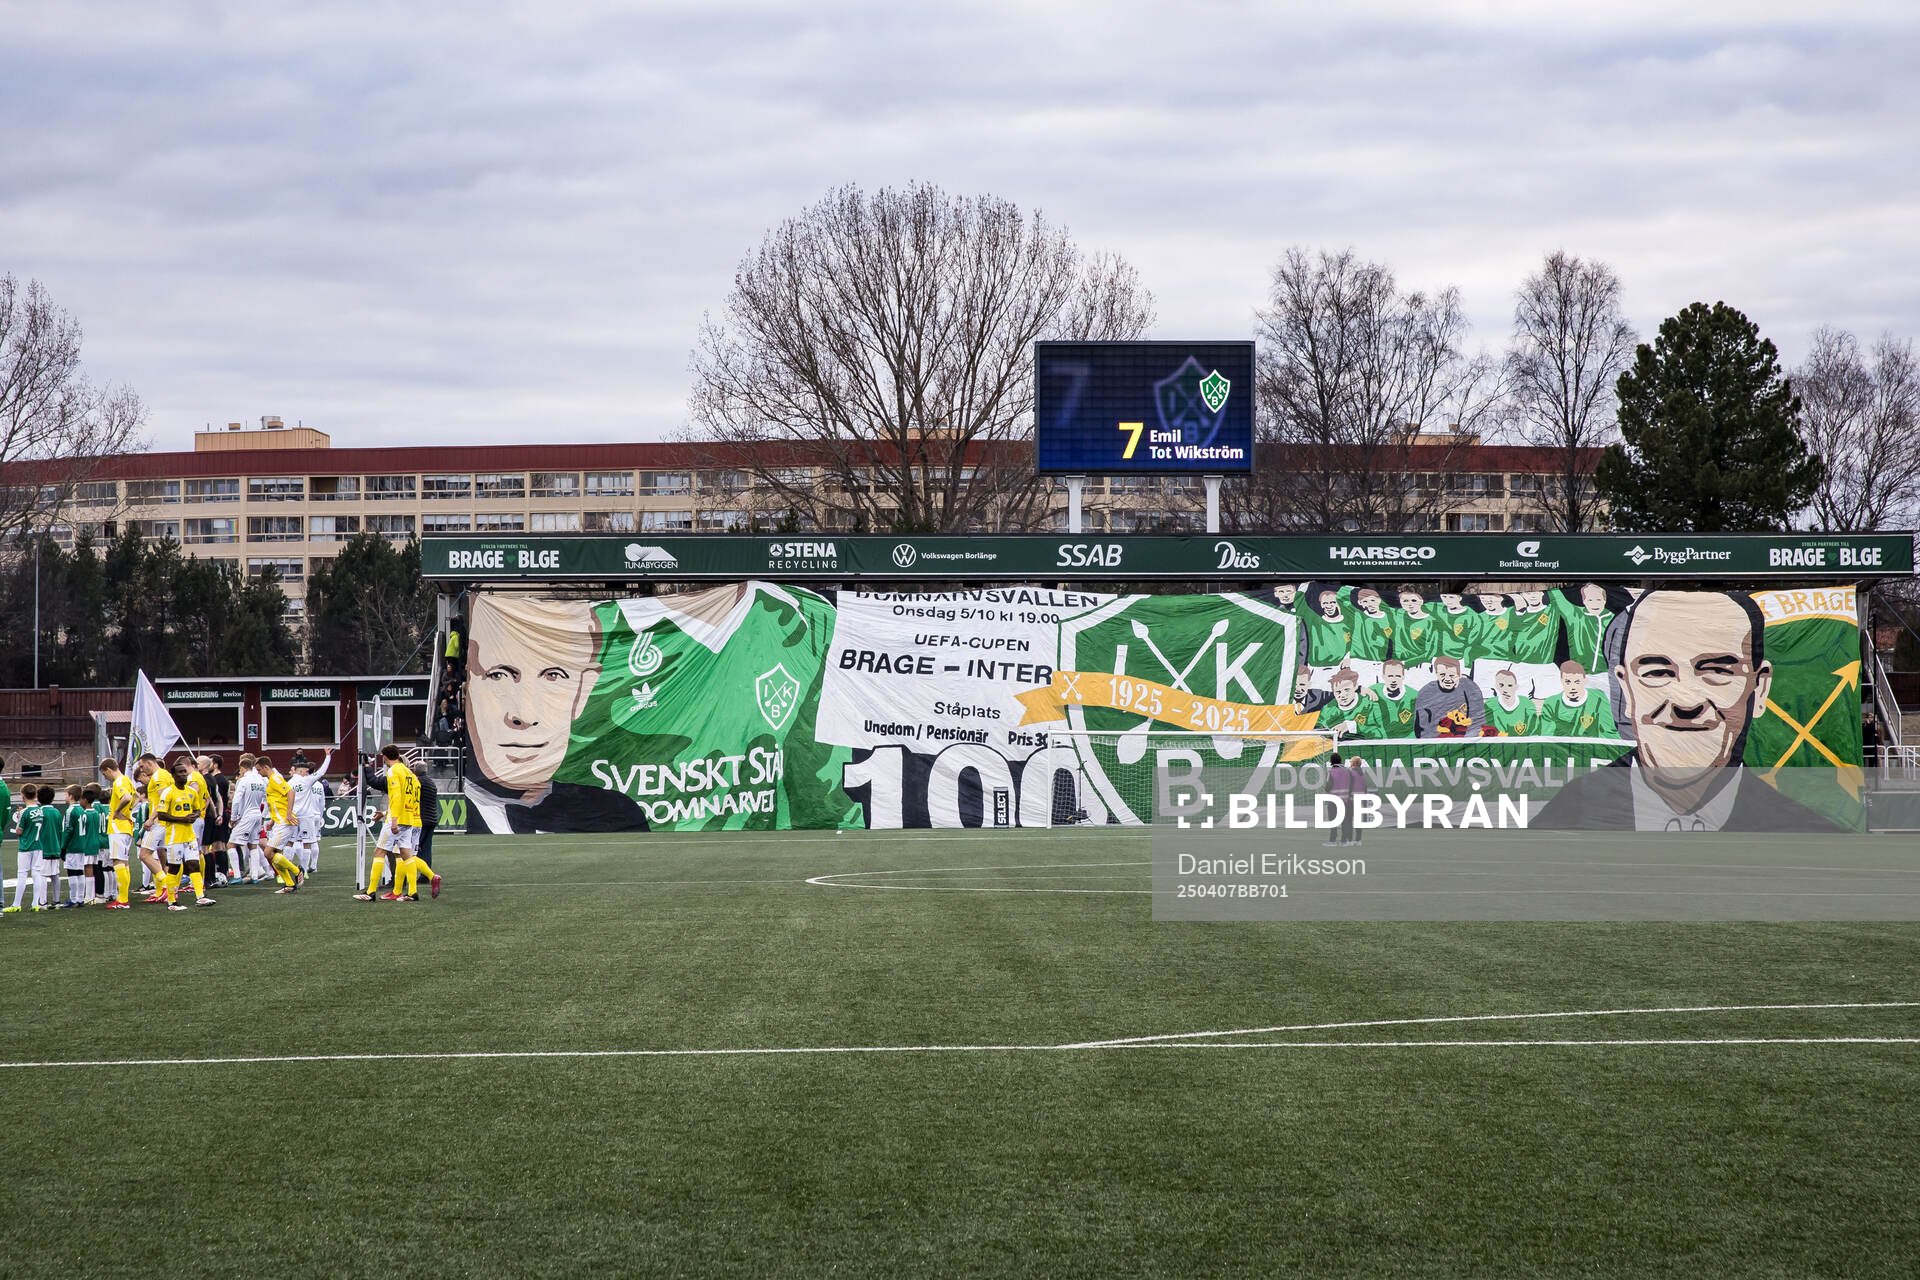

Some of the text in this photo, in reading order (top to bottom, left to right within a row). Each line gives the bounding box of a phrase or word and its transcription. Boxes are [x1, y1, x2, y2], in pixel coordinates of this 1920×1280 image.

[1118, 422, 1144, 459] 7
[1150, 429, 1181, 443] Emil
[1149, 445, 1243, 459] Tot Wikström
[784, 542, 837, 557] STENA
[921, 551, 997, 561] Volkswagen Borlänge
[1056, 544, 1123, 566] SSAB
[1214, 541, 1260, 569] Diös
[1329, 546, 1436, 559] HARSCO
[1654, 547, 1732, 564] ByggPartner
[1769, 548, 1882, 566] BRAGE BLGE
[449, 550, 560, 568] BRAGE BLGE
[624, 561, 678, 569] TUNABYGGEN
[769, 560, 837, 569] RECYCLING
[1499, 559, 1560, 569] Borlänge Energi
[1774, 591, 1856, 615] BRAGE
[893, 604, 1060, 624] Onsdag 5/10 kl 19.00
[914, 633, 1030, 651] UEFA-CUPEN
[839, 648, 936, 675] BRAGE
[967, 658, 1052, 685] INTER
[1216, 642, 1264, 704] K
[167, 689, 219, 699] SJÄLVSERVERING
[271, 688, 331, 698] BRAGE-BAREN
[380, 687, 413, 696] GRILLEN
[771, 705, 781, 718] B
[933, 701, 1001, 719] Ståplats
[1109, 678, 1163, 715] 1925
[1190, 703, 1251, 732] 2025
[864, 720, 916, 737] Ungdom
[926, 724, 989, 744] Pensionär
[1008, 730, 1033, 747] Pris
[591, 754, 746, 796] SVENSKT
[1156, 750, 1207, 816] B
[843, 742, 1108, 828] 100
[320, 805, 377, 828] SAB
[997, 792, 1007, 825] SELECT
[35, 822, 42, 841] 7
[78, 813, 87, 837] 12
